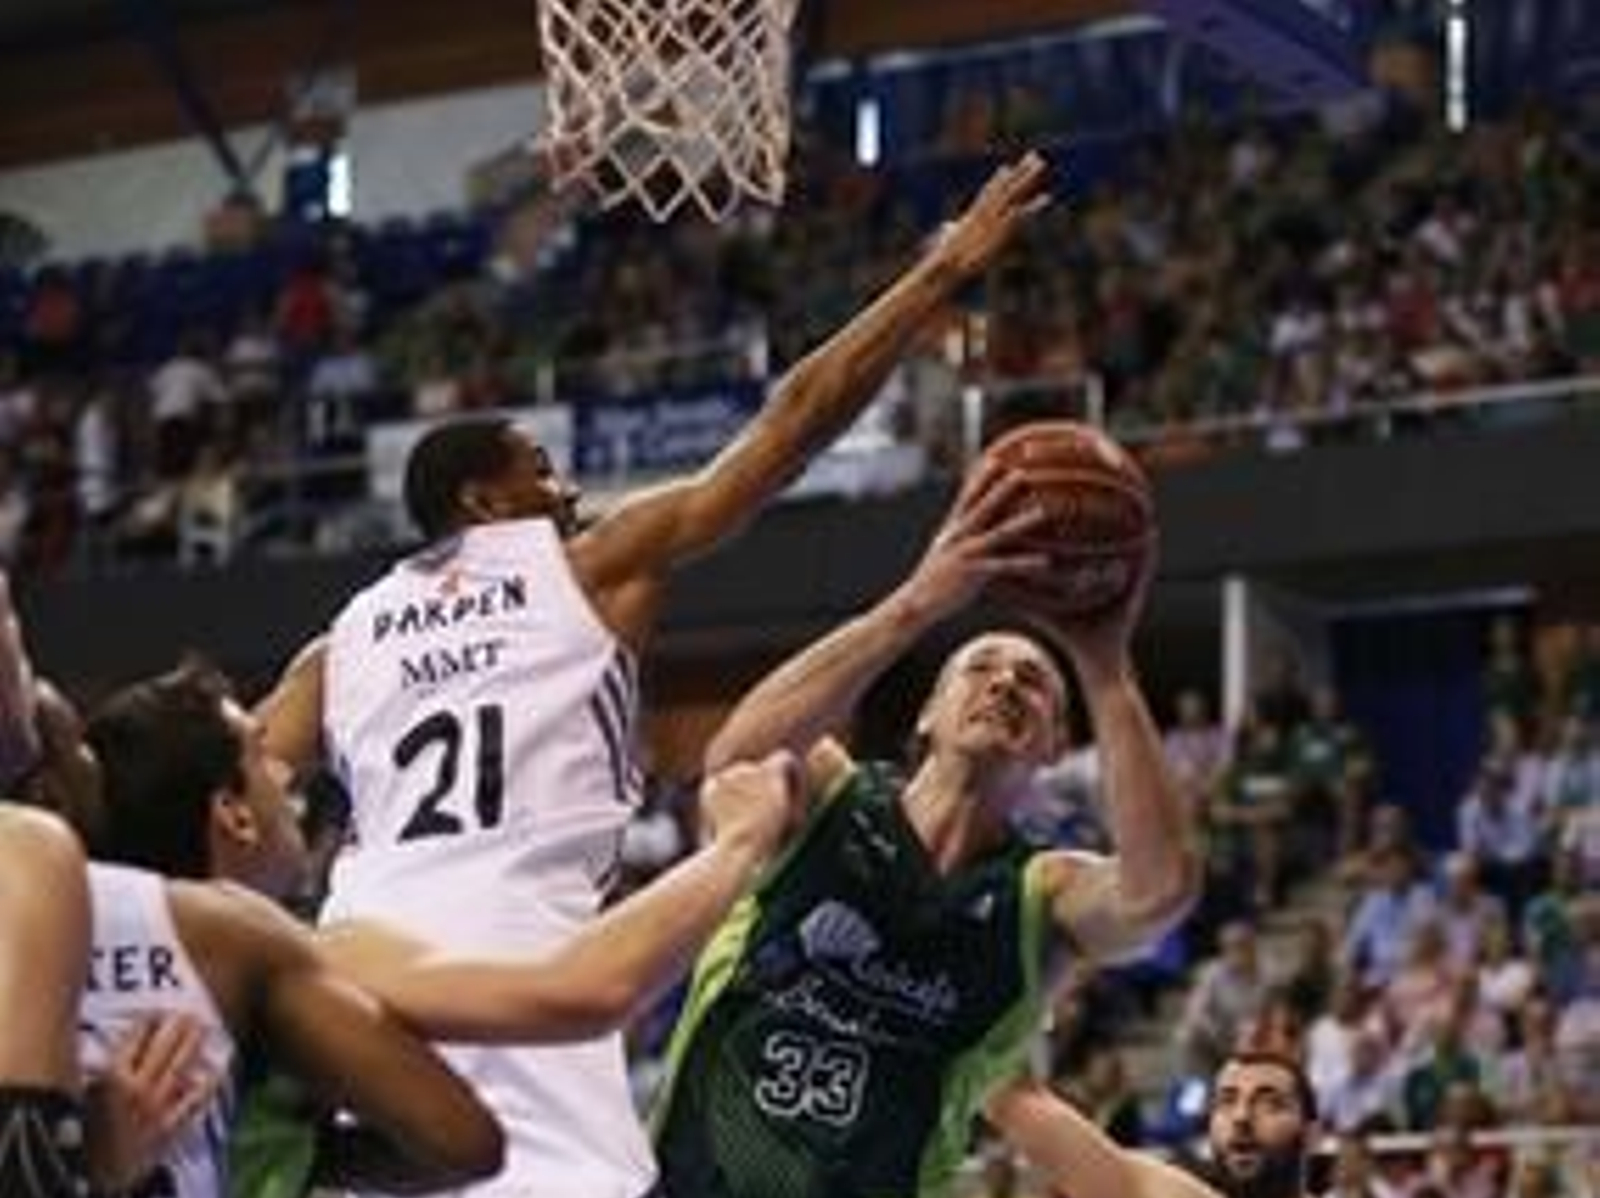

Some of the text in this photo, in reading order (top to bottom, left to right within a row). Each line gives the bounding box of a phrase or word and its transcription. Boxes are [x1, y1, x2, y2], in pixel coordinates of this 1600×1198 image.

[400, 638, 504, 690] MMT
[393, 703, 504, 845] 21
[754, 1031, 870, 1128] 33
